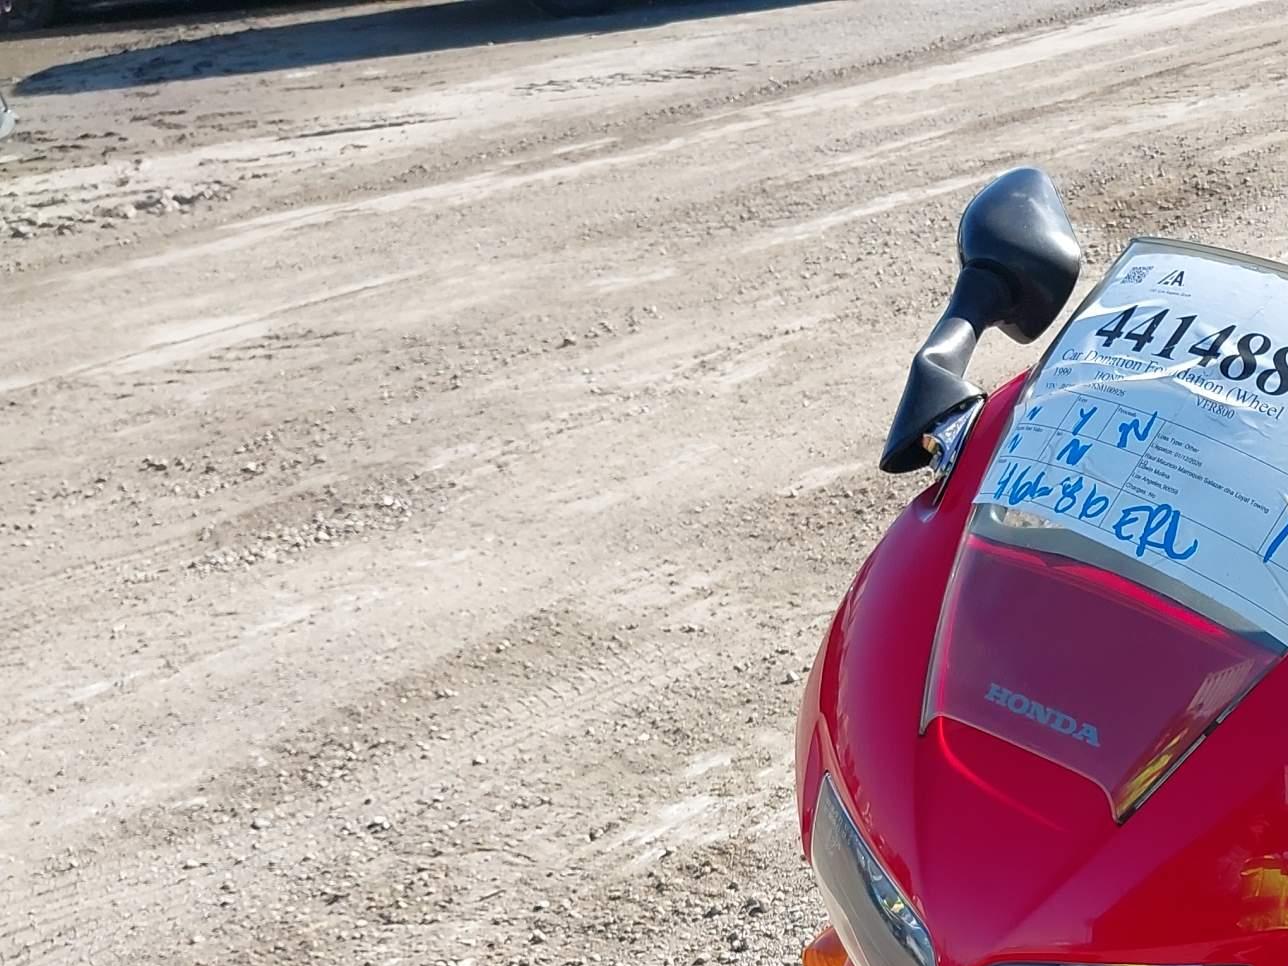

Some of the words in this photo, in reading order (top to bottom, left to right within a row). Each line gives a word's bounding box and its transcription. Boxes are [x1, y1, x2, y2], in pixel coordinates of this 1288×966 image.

[1054, 367, 1072, 376] 1999
[1195, 396, 1235, 420] VFR800
[1062, 349, 1083, 361] Car
[1084, 351, 1142, 371] Donation
[1225, 386, 1286, 420] (Wheel
[1234, 491, 1251, 504] Loyal
[1250, 499, 1270, 514] Towing
[984, 682, 1100, 747] HONDA
